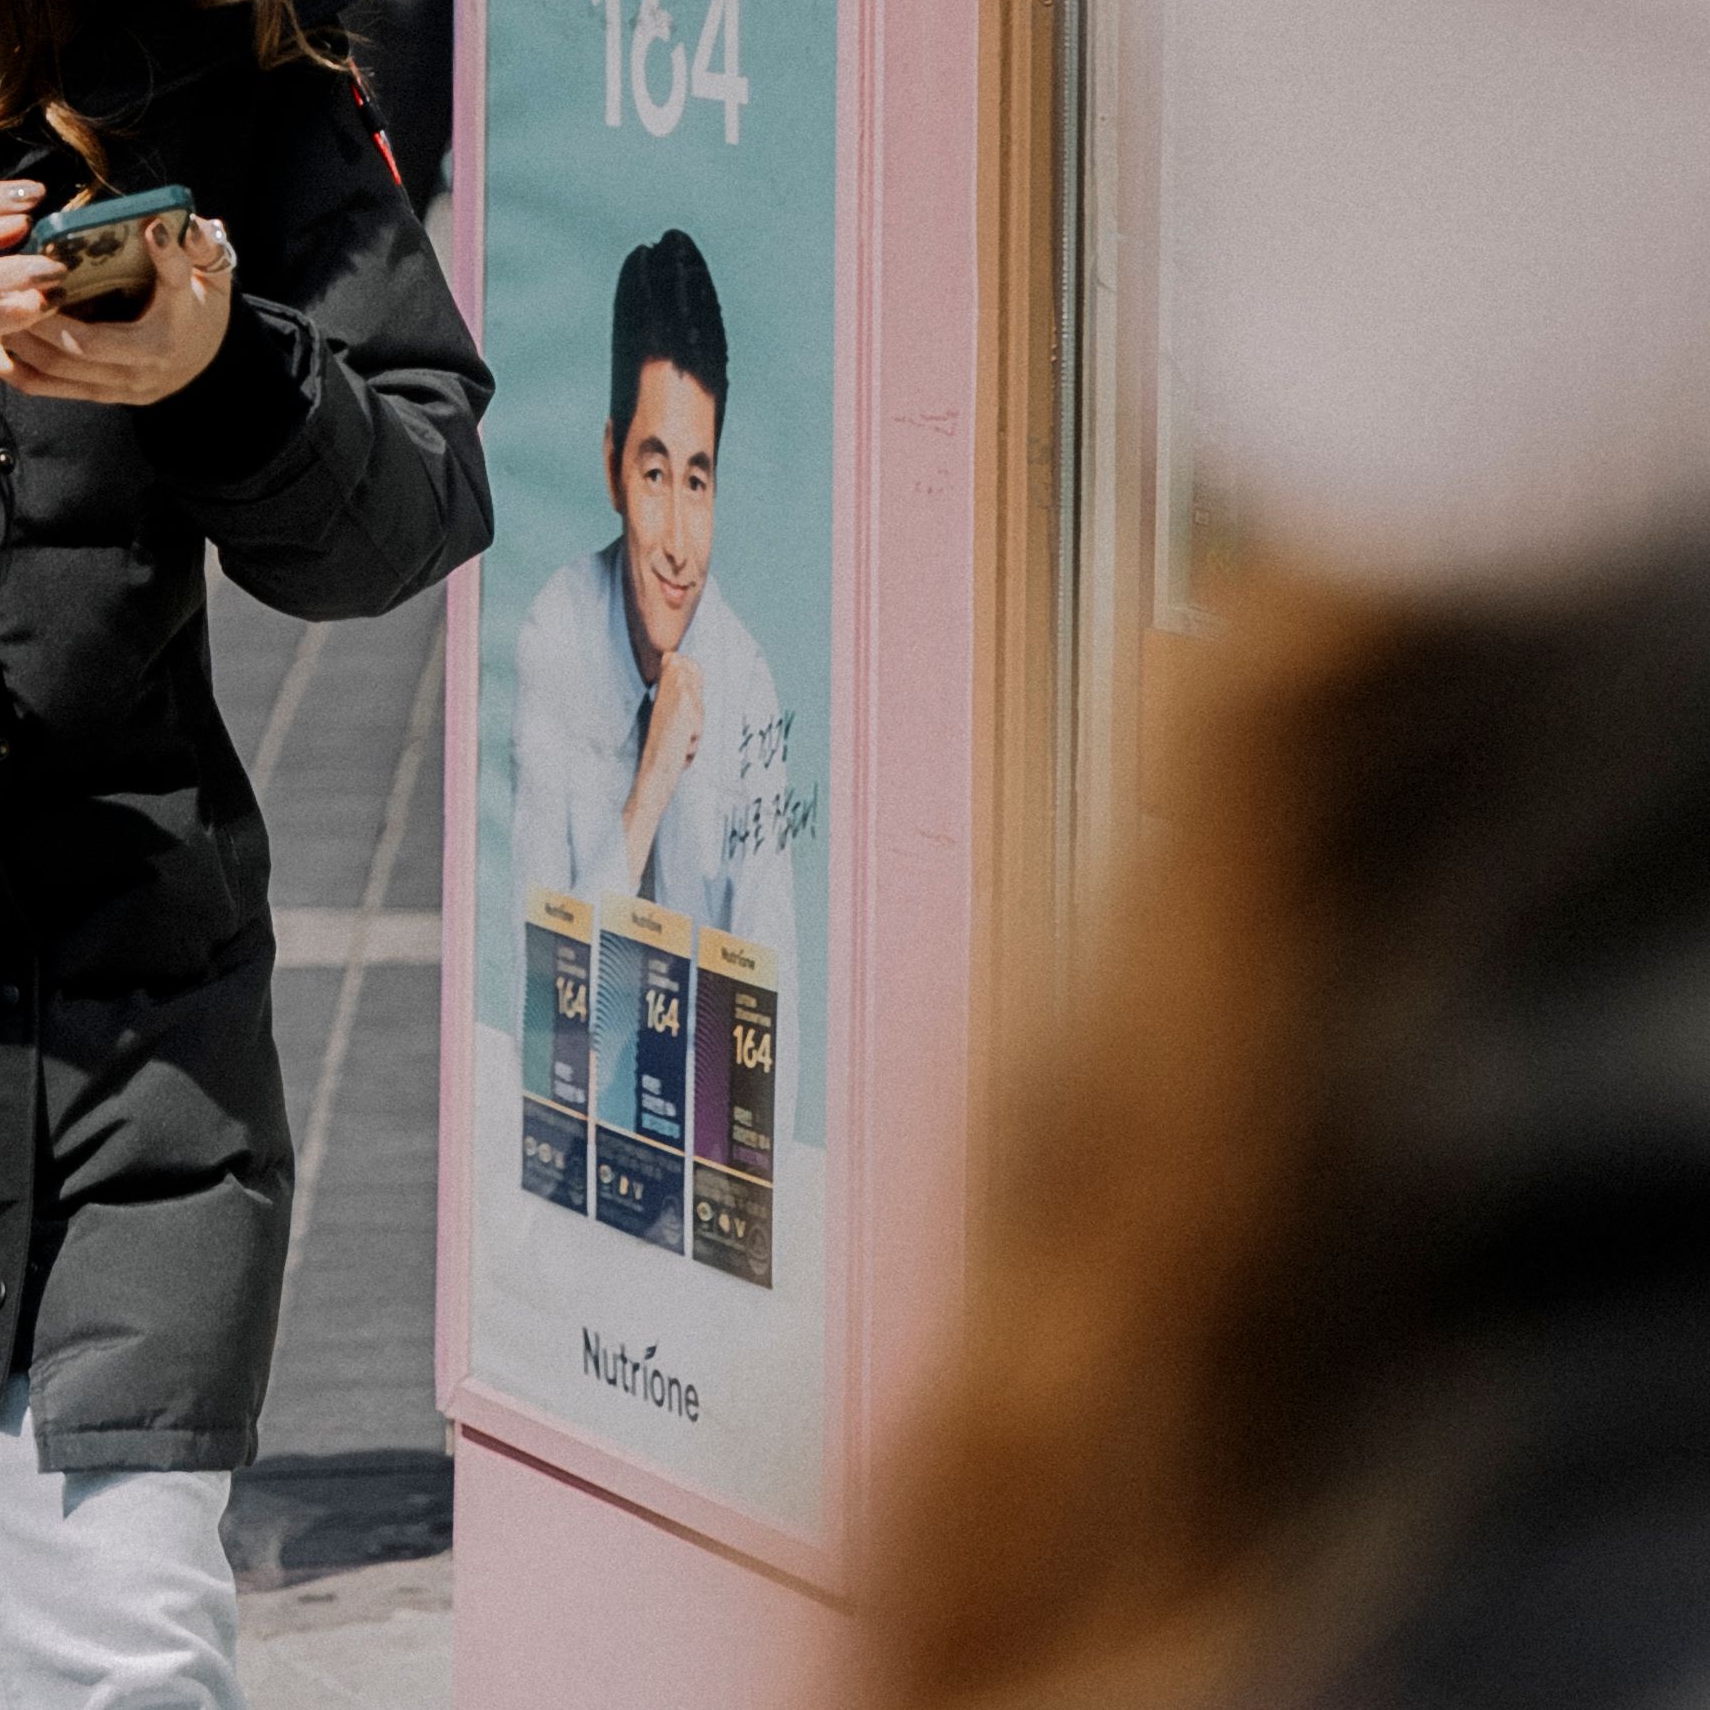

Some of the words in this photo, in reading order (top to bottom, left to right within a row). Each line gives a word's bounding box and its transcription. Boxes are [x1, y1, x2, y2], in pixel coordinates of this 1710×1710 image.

[556, 975, 587, 1023] 164
[645, 988, 680, 1038] 164
[732, 1024, 773, 1074] 164
